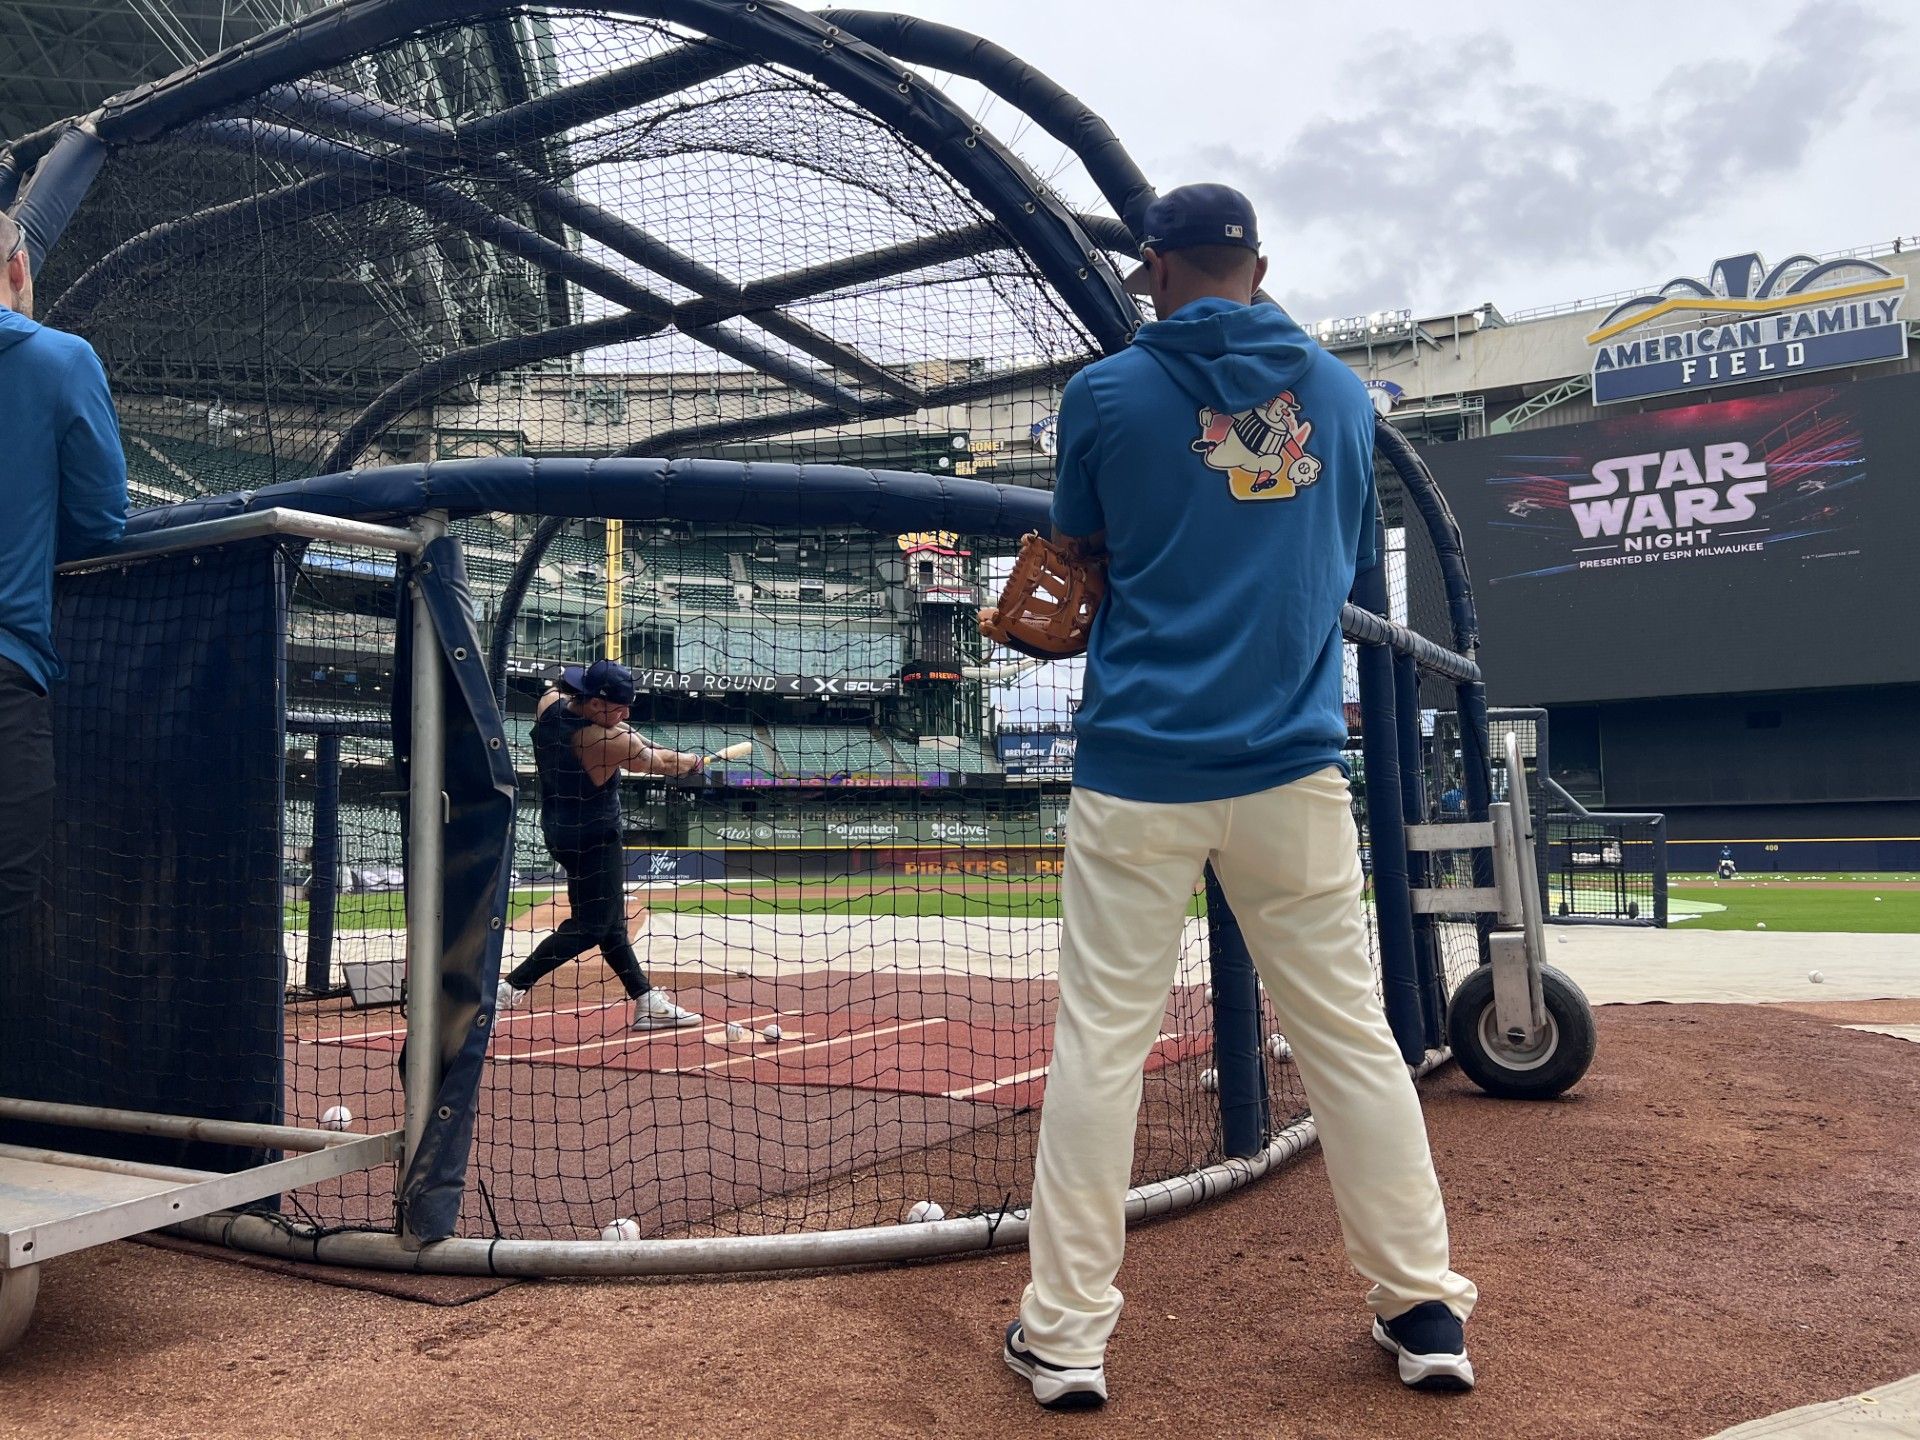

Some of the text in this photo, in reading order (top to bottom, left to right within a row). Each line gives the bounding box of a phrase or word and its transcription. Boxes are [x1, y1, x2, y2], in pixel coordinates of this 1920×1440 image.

[1594, 296, 1901, 371] AMERICAN FAMILY
[1681, 341, 1806, 384] FIELD
[967, 439, 1005, 453] GONE!
[955, 466, 977, 476] HERE
[1568, 441, 1767, 500] STAR
[1569, 479, 1768, 539] WARS
[1624, 528, 1712, 552] NIGHT
[1579, 541, 1764, 570] PRESENTED BY ESPN MILWAUKEE
[640, 671, 691, 690] YEAR
[703, 674, 778, 692] ROUND
[843, 680, 896, 692] GOLF
[1004, 748, 1045, 757] BREW CREW
[1025, 766, 1044, 774] GREAT
[716, 825, 752, 841] Tito's
[827, 823, 899, 836] Polymatech
[946, 822, 990, 836] clover
[904, 859, 1008, 875] PIRATES
